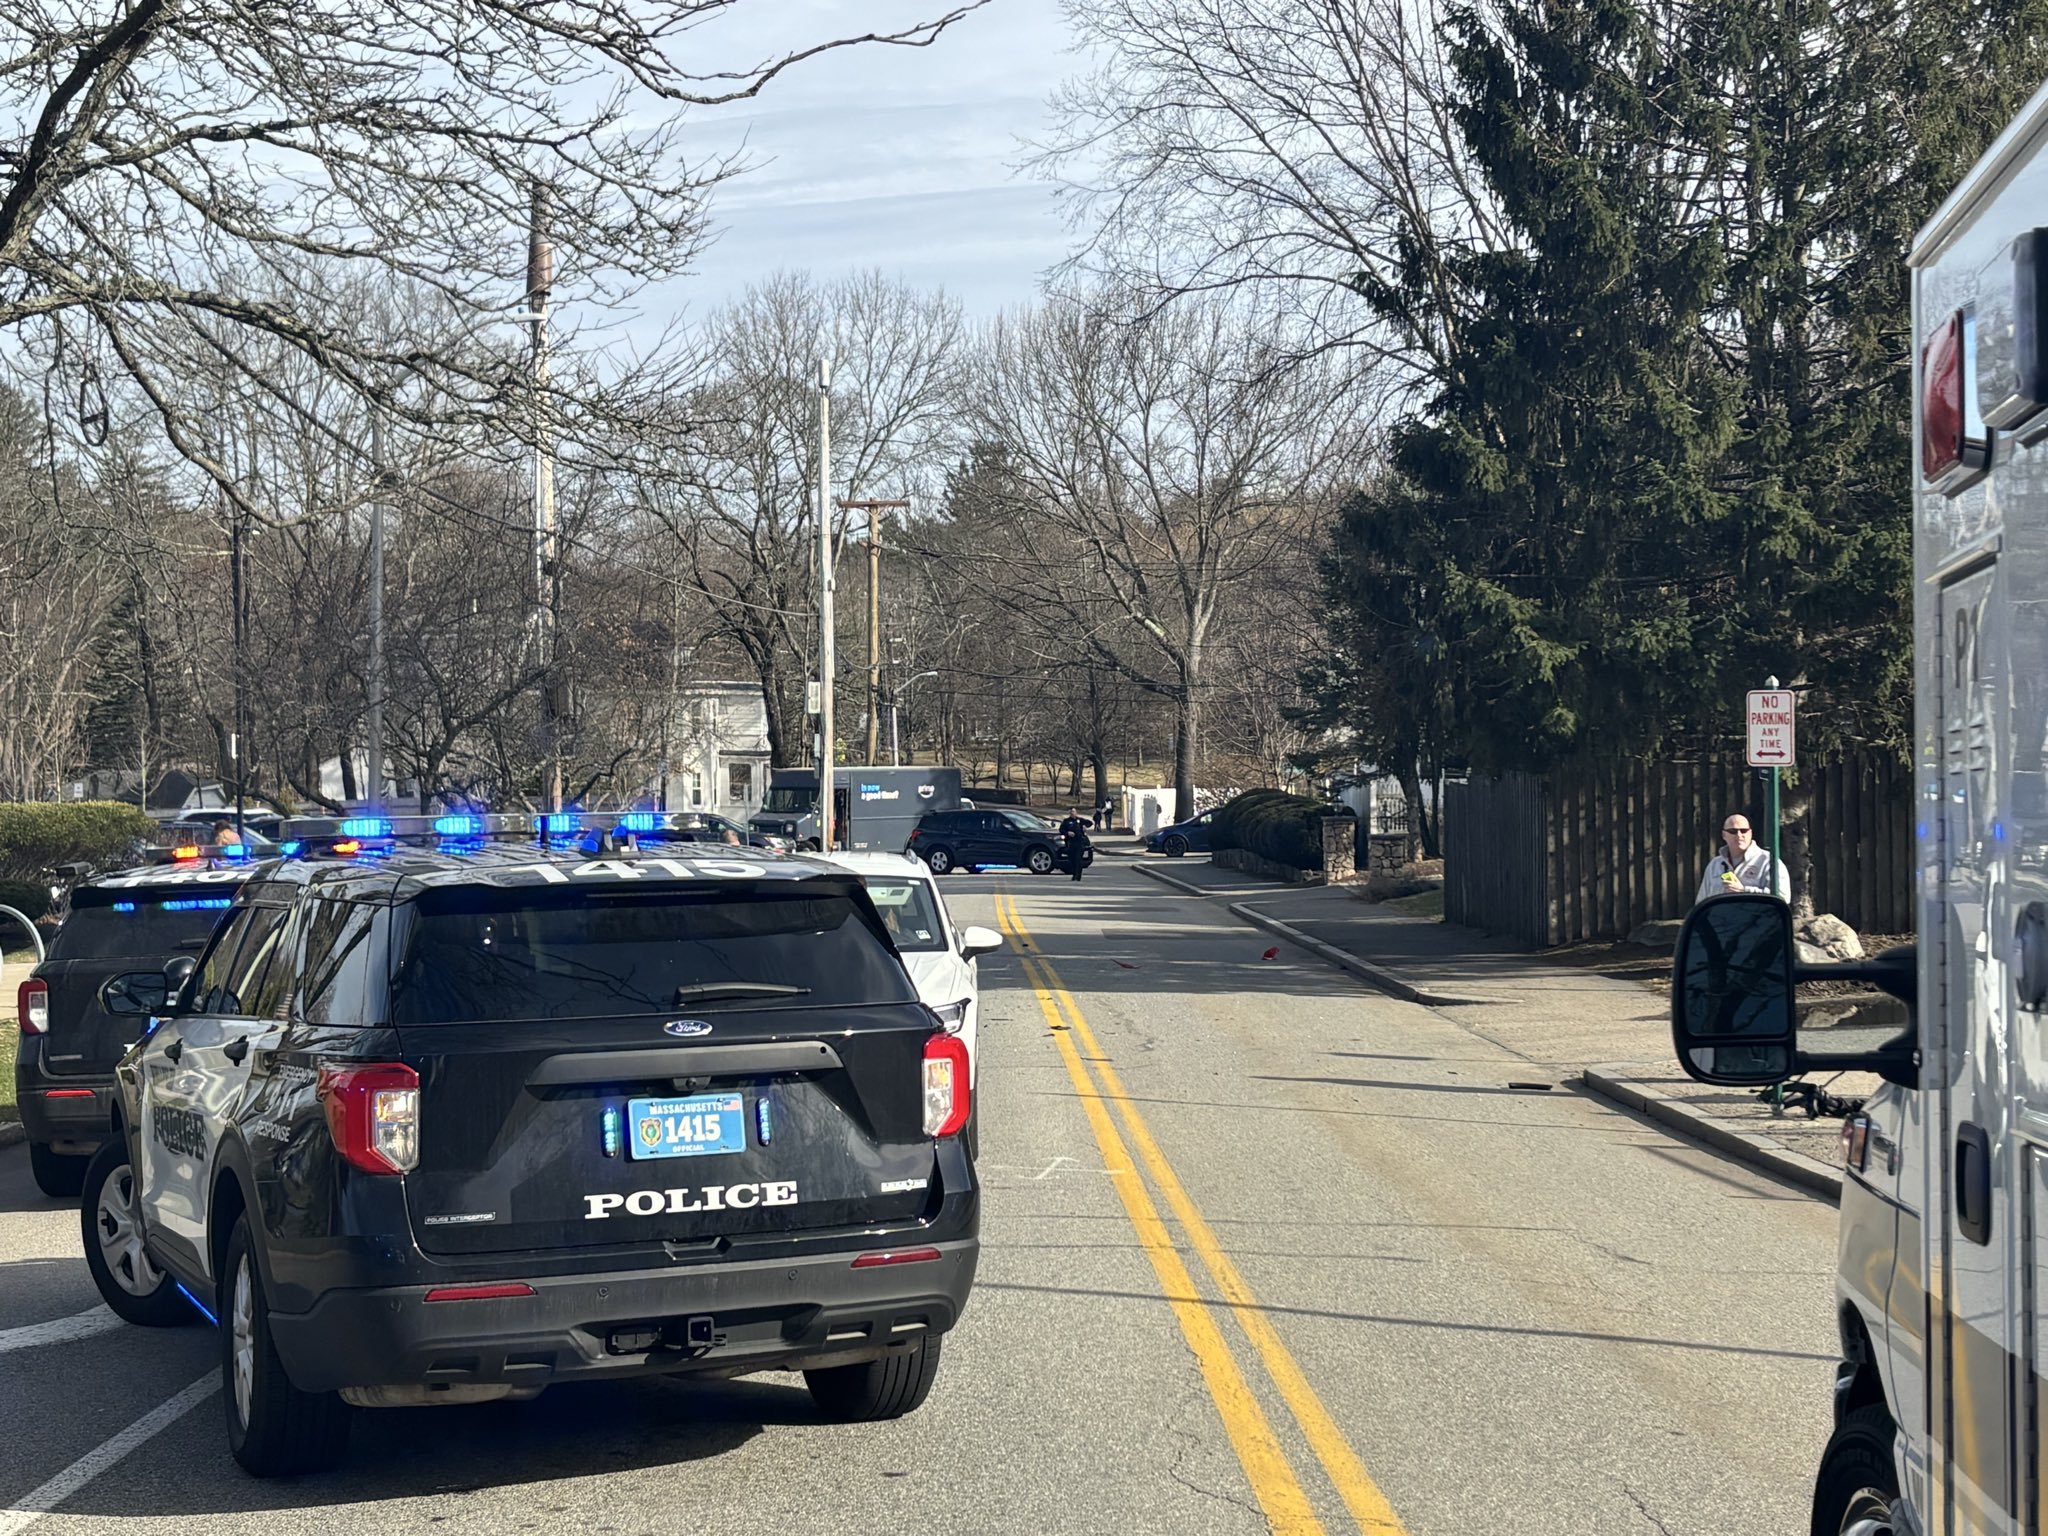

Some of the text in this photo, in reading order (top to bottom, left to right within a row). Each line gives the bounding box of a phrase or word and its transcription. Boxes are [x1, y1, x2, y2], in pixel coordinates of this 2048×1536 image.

[1761, 695, 1778, 709] NO
[1751, 712, 1790, 725] PARKING
[1761, 727, 1780, 737] ANY
[1760, 739, 1781, 748] TIME
[510, 858, 767, 884] 1415
[675, 1020, 702, 1033] Ford
[277, 1063, 312, 1084] EMERGENCY
[649, 1101, 724, 1115] MASSACHUSETTS
[254, 1119, 291, 1143] RESPONSE
[665, 1114, 721, 1144] 1415
[672, 1144, 705, 1153] OFFICIAL
[584, 1180, 799, 1220] POLICE
